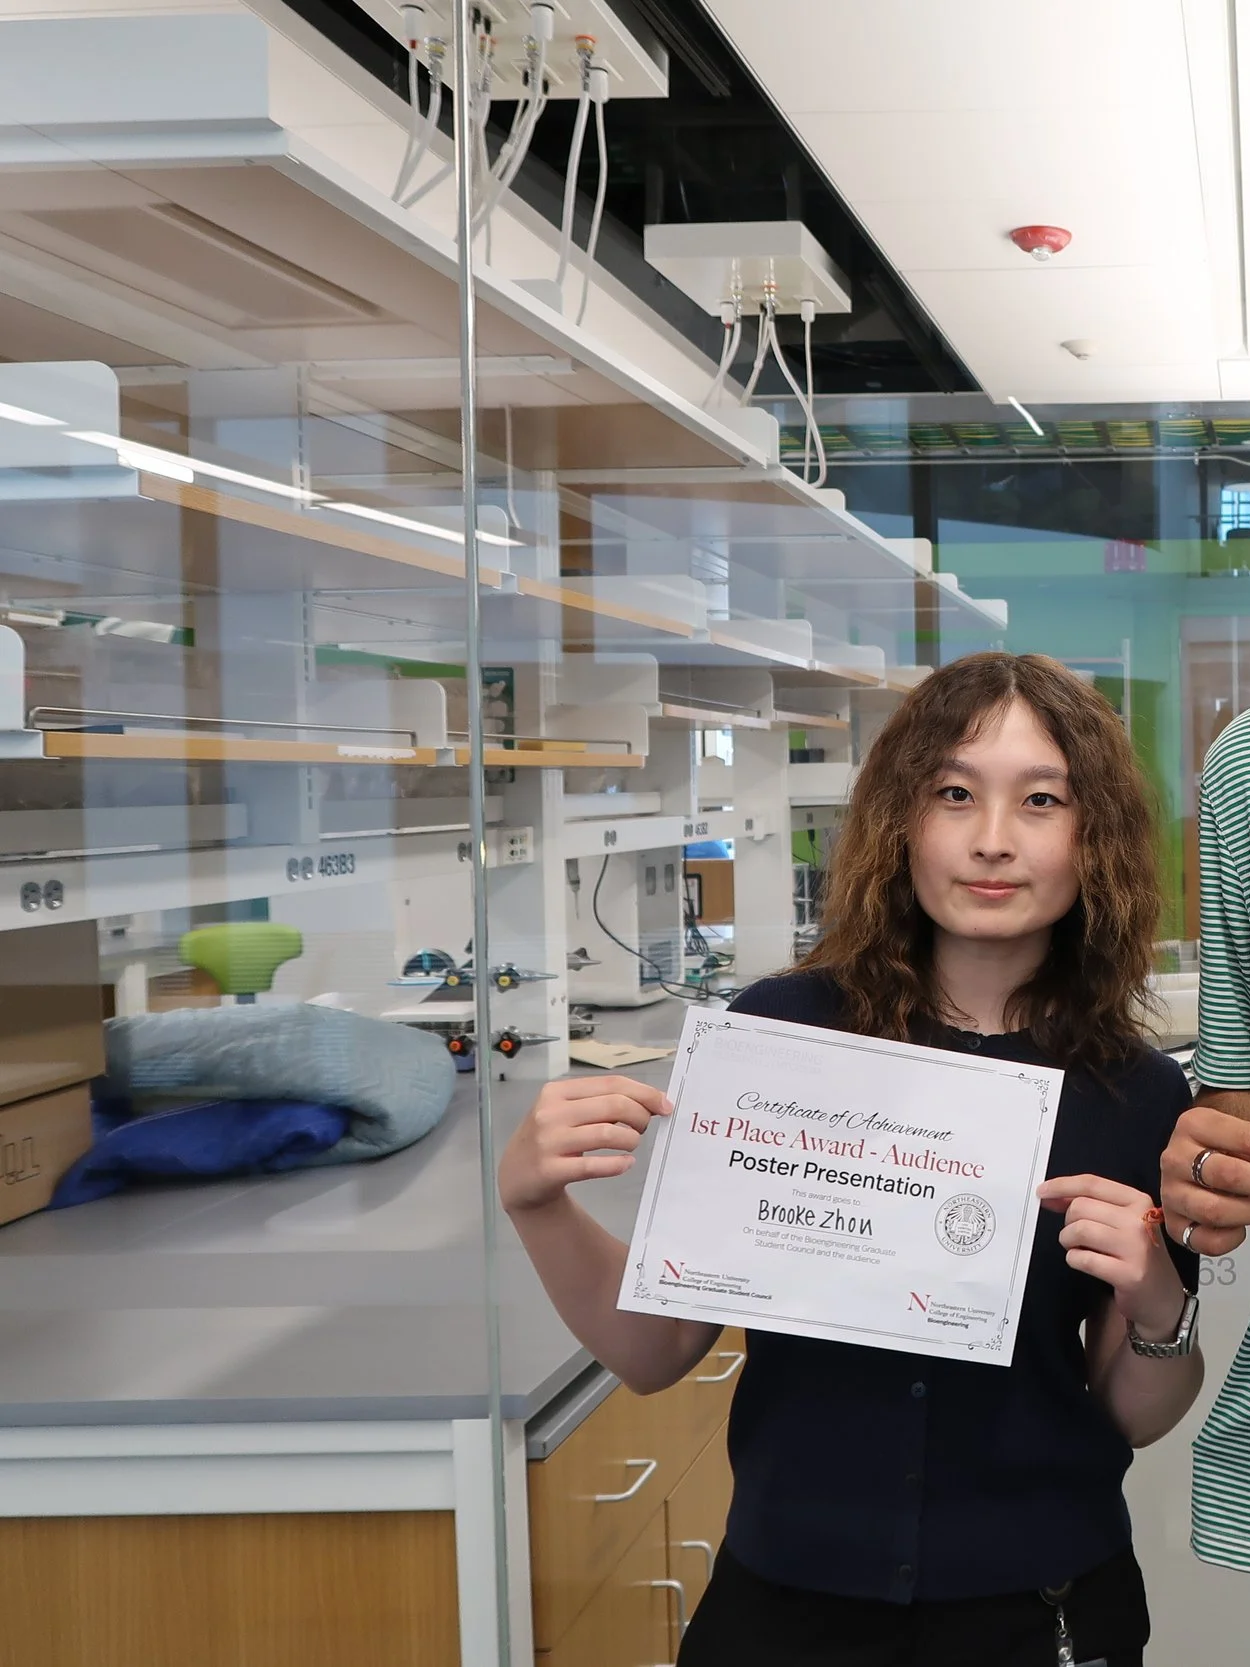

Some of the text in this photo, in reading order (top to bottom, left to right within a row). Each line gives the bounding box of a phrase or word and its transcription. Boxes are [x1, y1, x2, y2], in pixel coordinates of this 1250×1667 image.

[318, 853, 355, 877] 463B3
[736, 1091, 955, 1141] Certificate of Achievement
[689, 1112, 720, 1136] 1st
[724, 1116, 786, 1146] Place
[790, 1128, 865, 1159] Award
[881, 1144, 985, 1178] Audience
[729, 1150, 936, 1199] Poster Presentation
[792, 1189, 807, 1197] This
[809, 1191, 831, 1202] award
[832, 1197, 851, 1206] goes
[943, 1196, 992, 1218] NORTHEASTERN
[742, 1226, 897, 1257] On behalf of the Bioengineering Graduate
[754, 1239, 881, 1265] Student Council and the audience
[942, 1236, 981, 1253] UNIVERSITY
[661, 1259, 685, 1280] N
[684, 1268, 750, 1283] Northeastern University
[659, 1279, 772, 1300] Bioengineering Graduate Student Council
[682, 1276, 702, 1285] College
[709, 1280, 741, 1290] Engineering
[907, 1291, 931, 1312] N
[930, 1301, 995, 1317] Northeastern University
[927, 1317, 969, 1329] Bioengineering
[928, 1309, 948, 1317] College
[955, 1313, 987, 1323] Engineering
